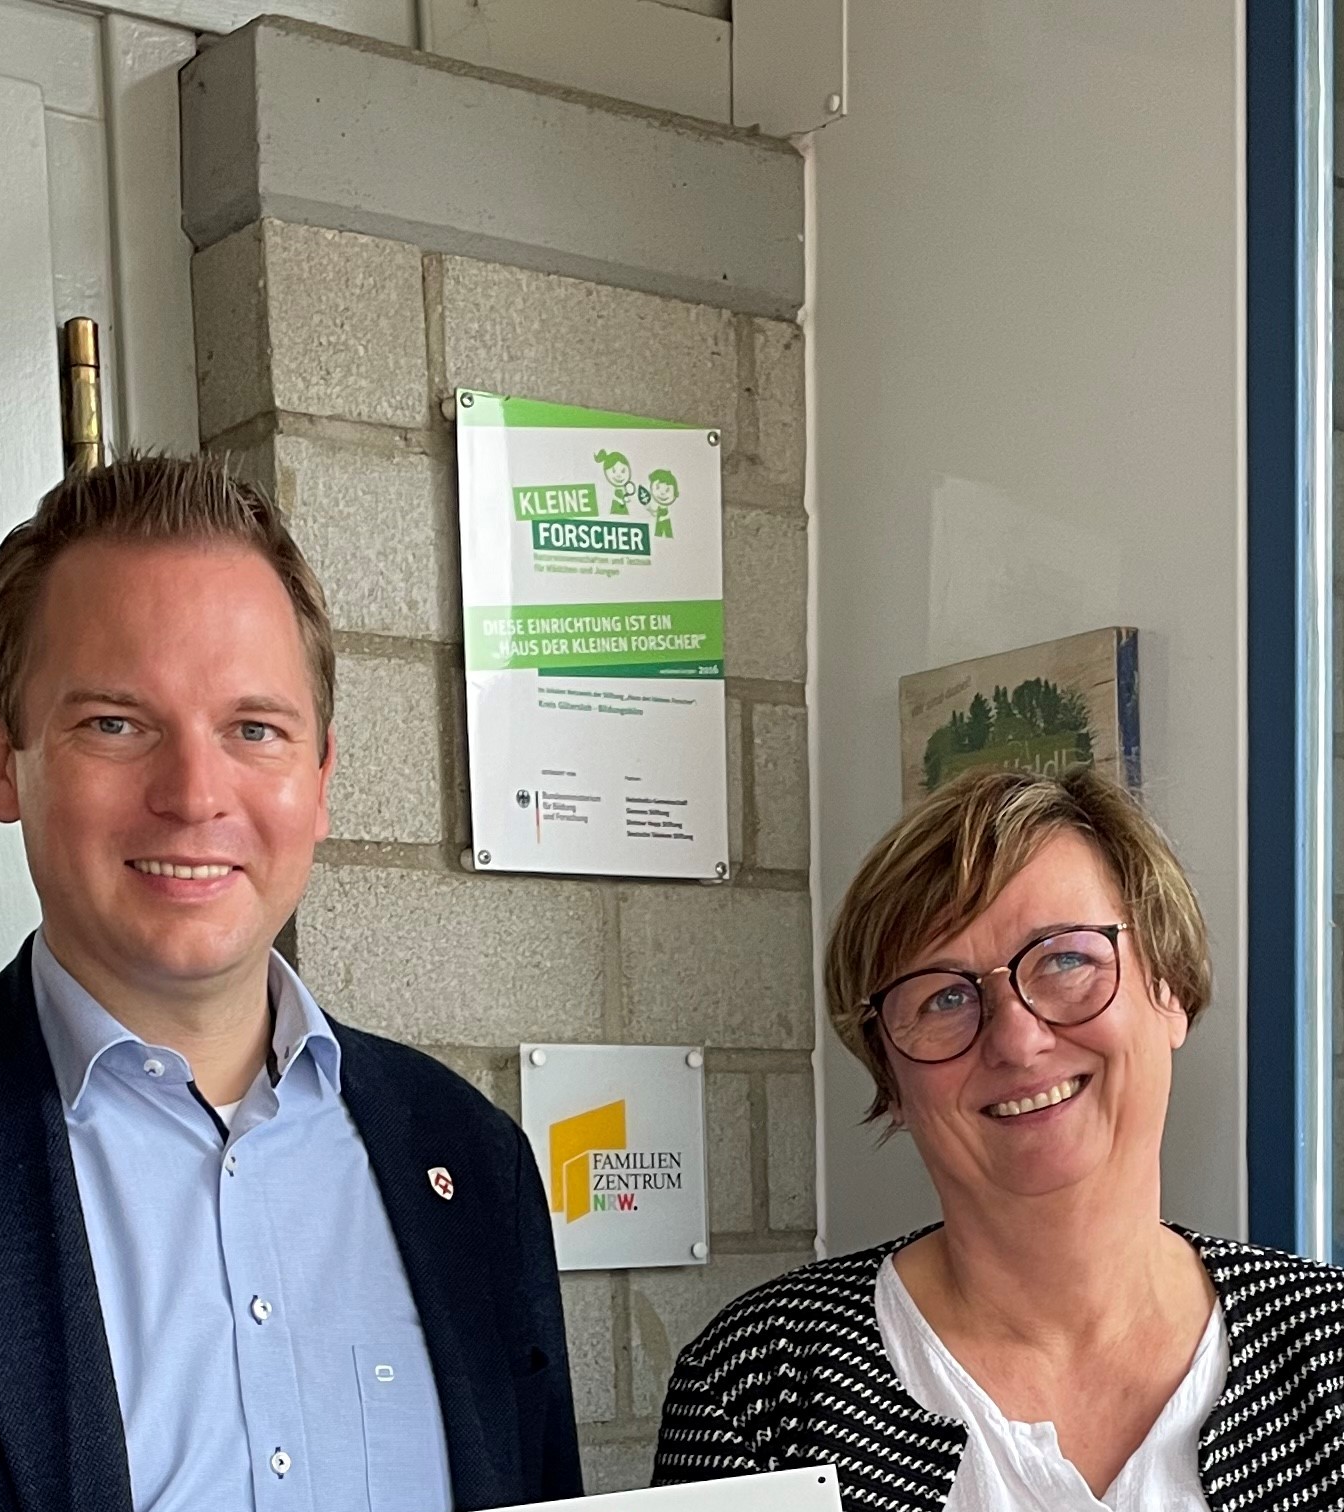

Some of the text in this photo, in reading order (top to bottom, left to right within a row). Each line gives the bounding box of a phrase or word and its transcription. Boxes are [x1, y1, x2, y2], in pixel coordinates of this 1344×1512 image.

[519, 488, 592, 516] KLEINE
[538, 522, 645, 551] FORSCHER
[482, 614, 672, 636] DIESE EINRICHTUNG IST EIN
[541, 638, 570, 656] DER
[571, 636, 629, 654] KLEINEN
[592, 1151, 682, 1170] FAMILIEN
[593, 1172, 683, 1191] ZENTRUM
